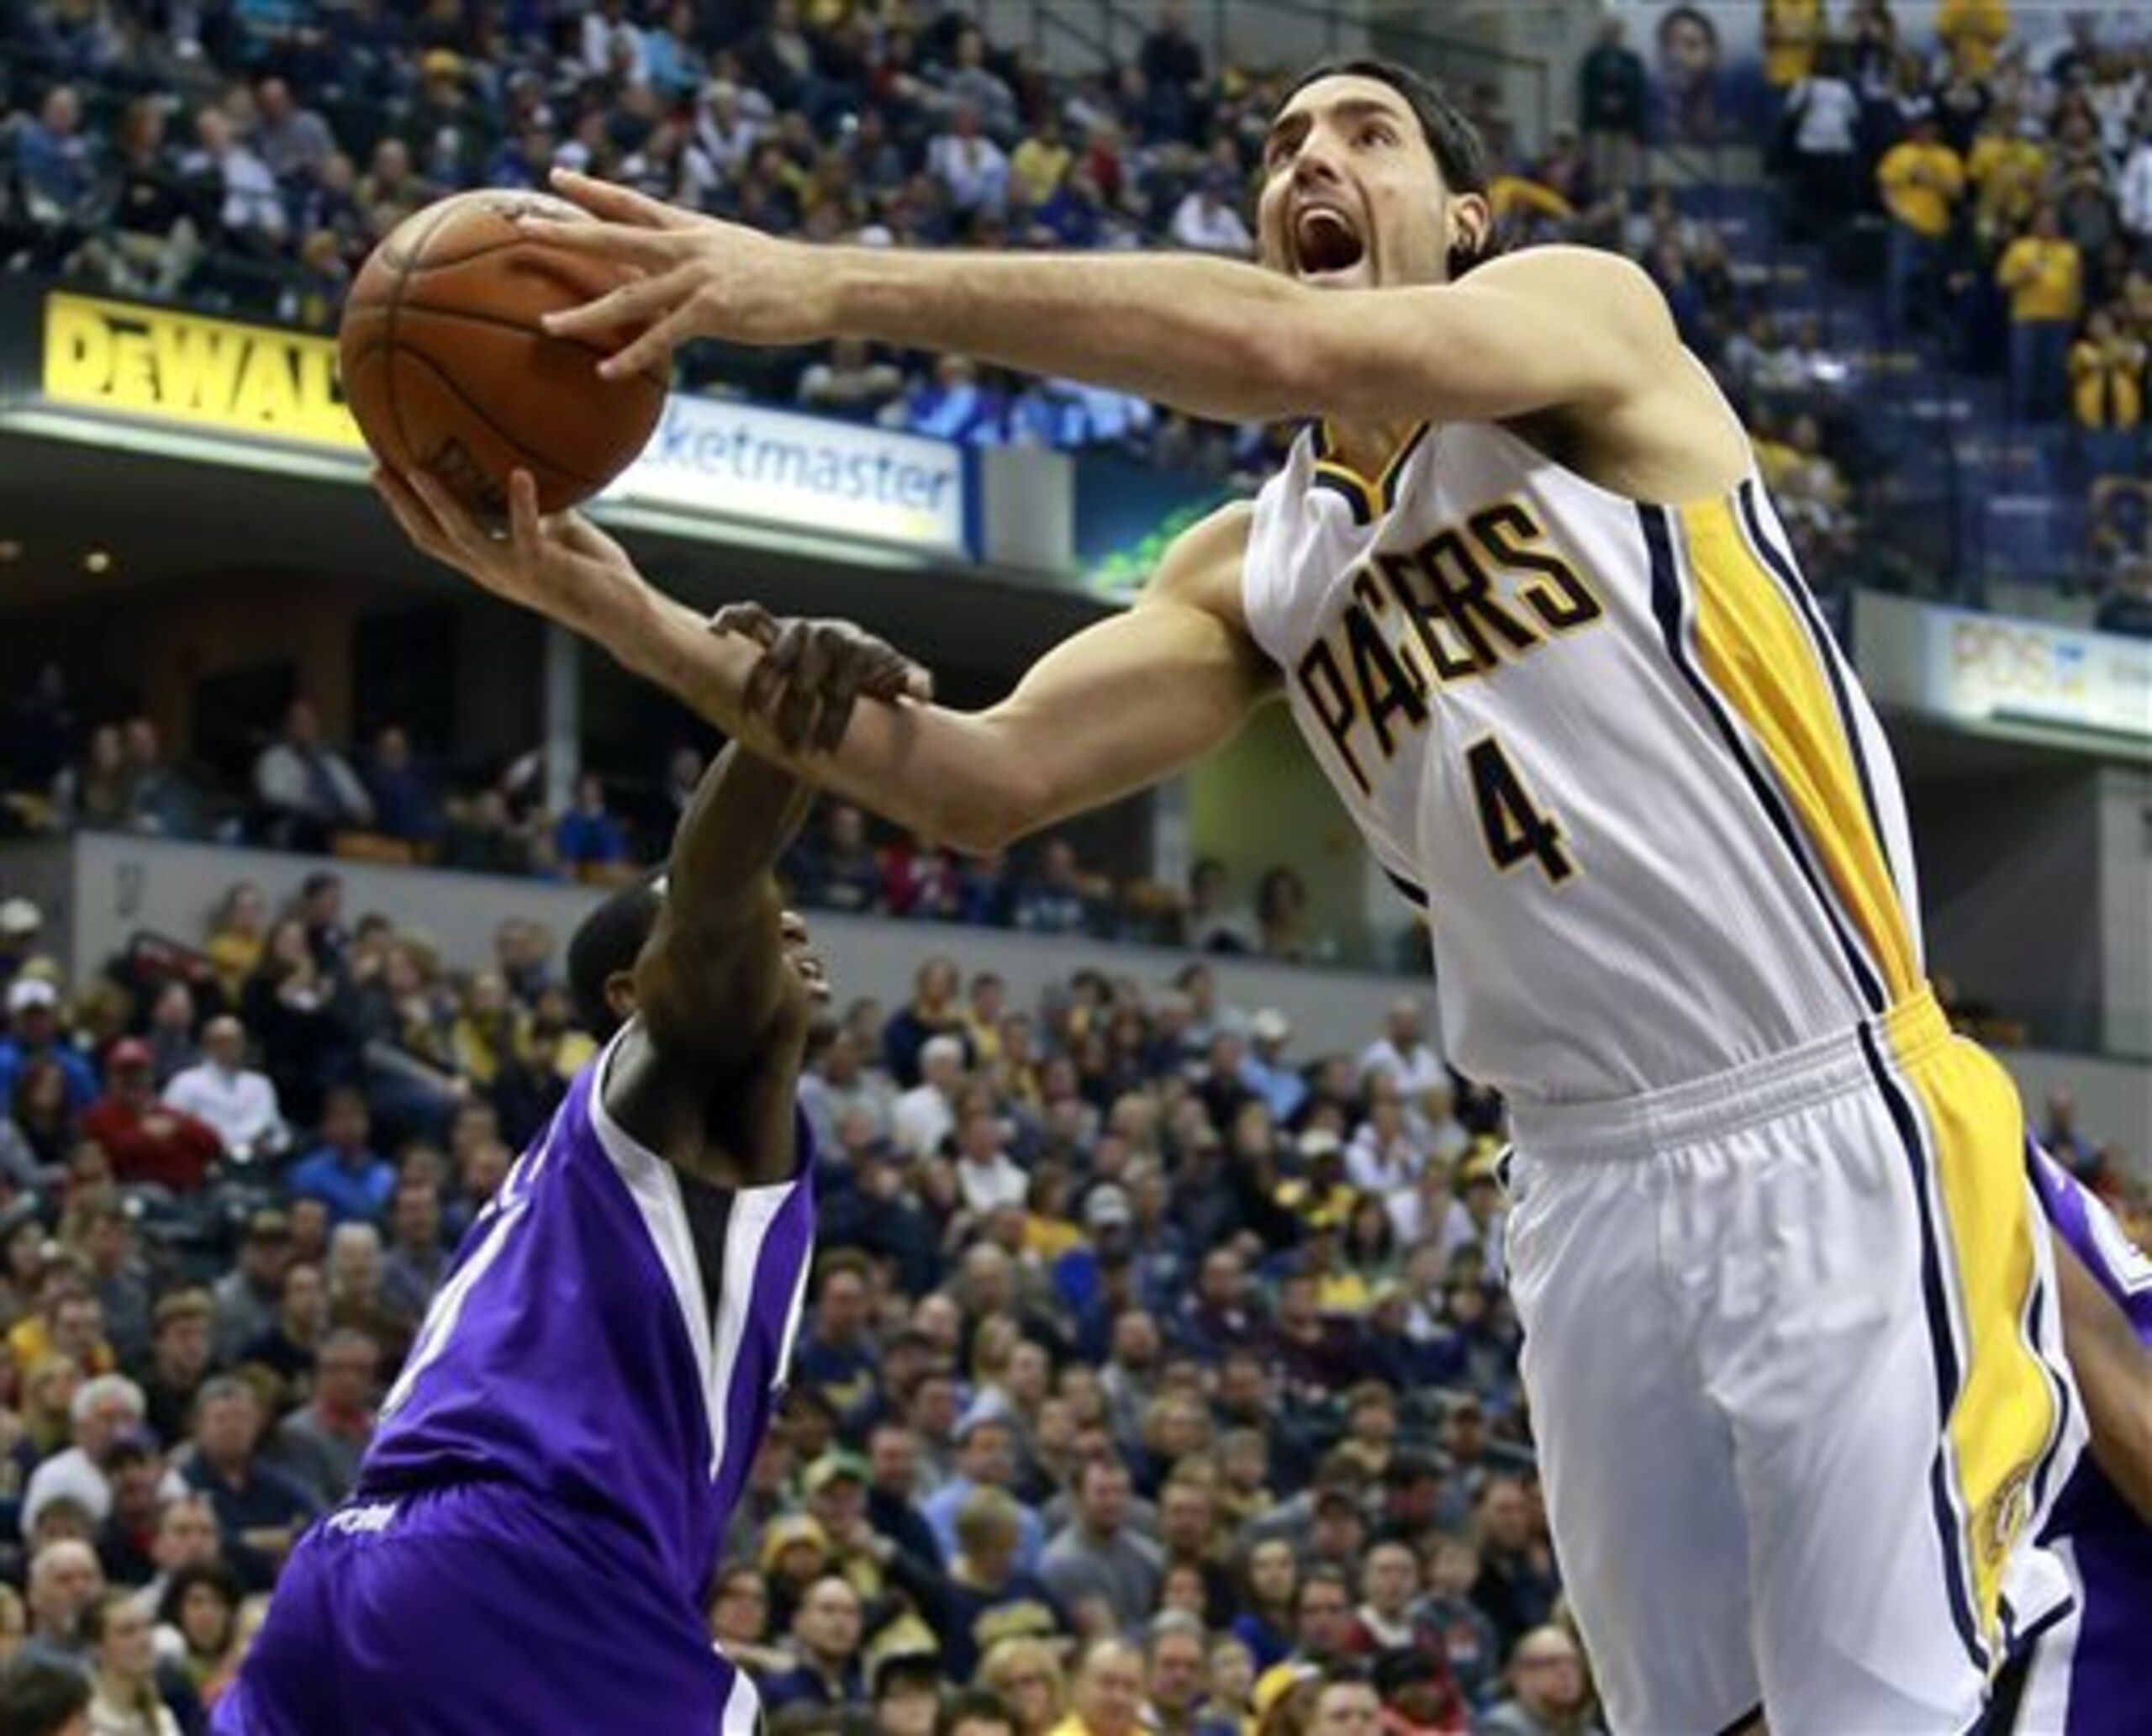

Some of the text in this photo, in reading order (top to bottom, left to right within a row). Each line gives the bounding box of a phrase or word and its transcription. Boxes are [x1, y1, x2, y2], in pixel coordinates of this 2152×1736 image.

[57, 301, 351, 430] DEWAL
[659, 397, 957, 509] ketmaster
[1295, 496, 1604, 797] PACERS
[1464, 736, 1584, 891] 4
